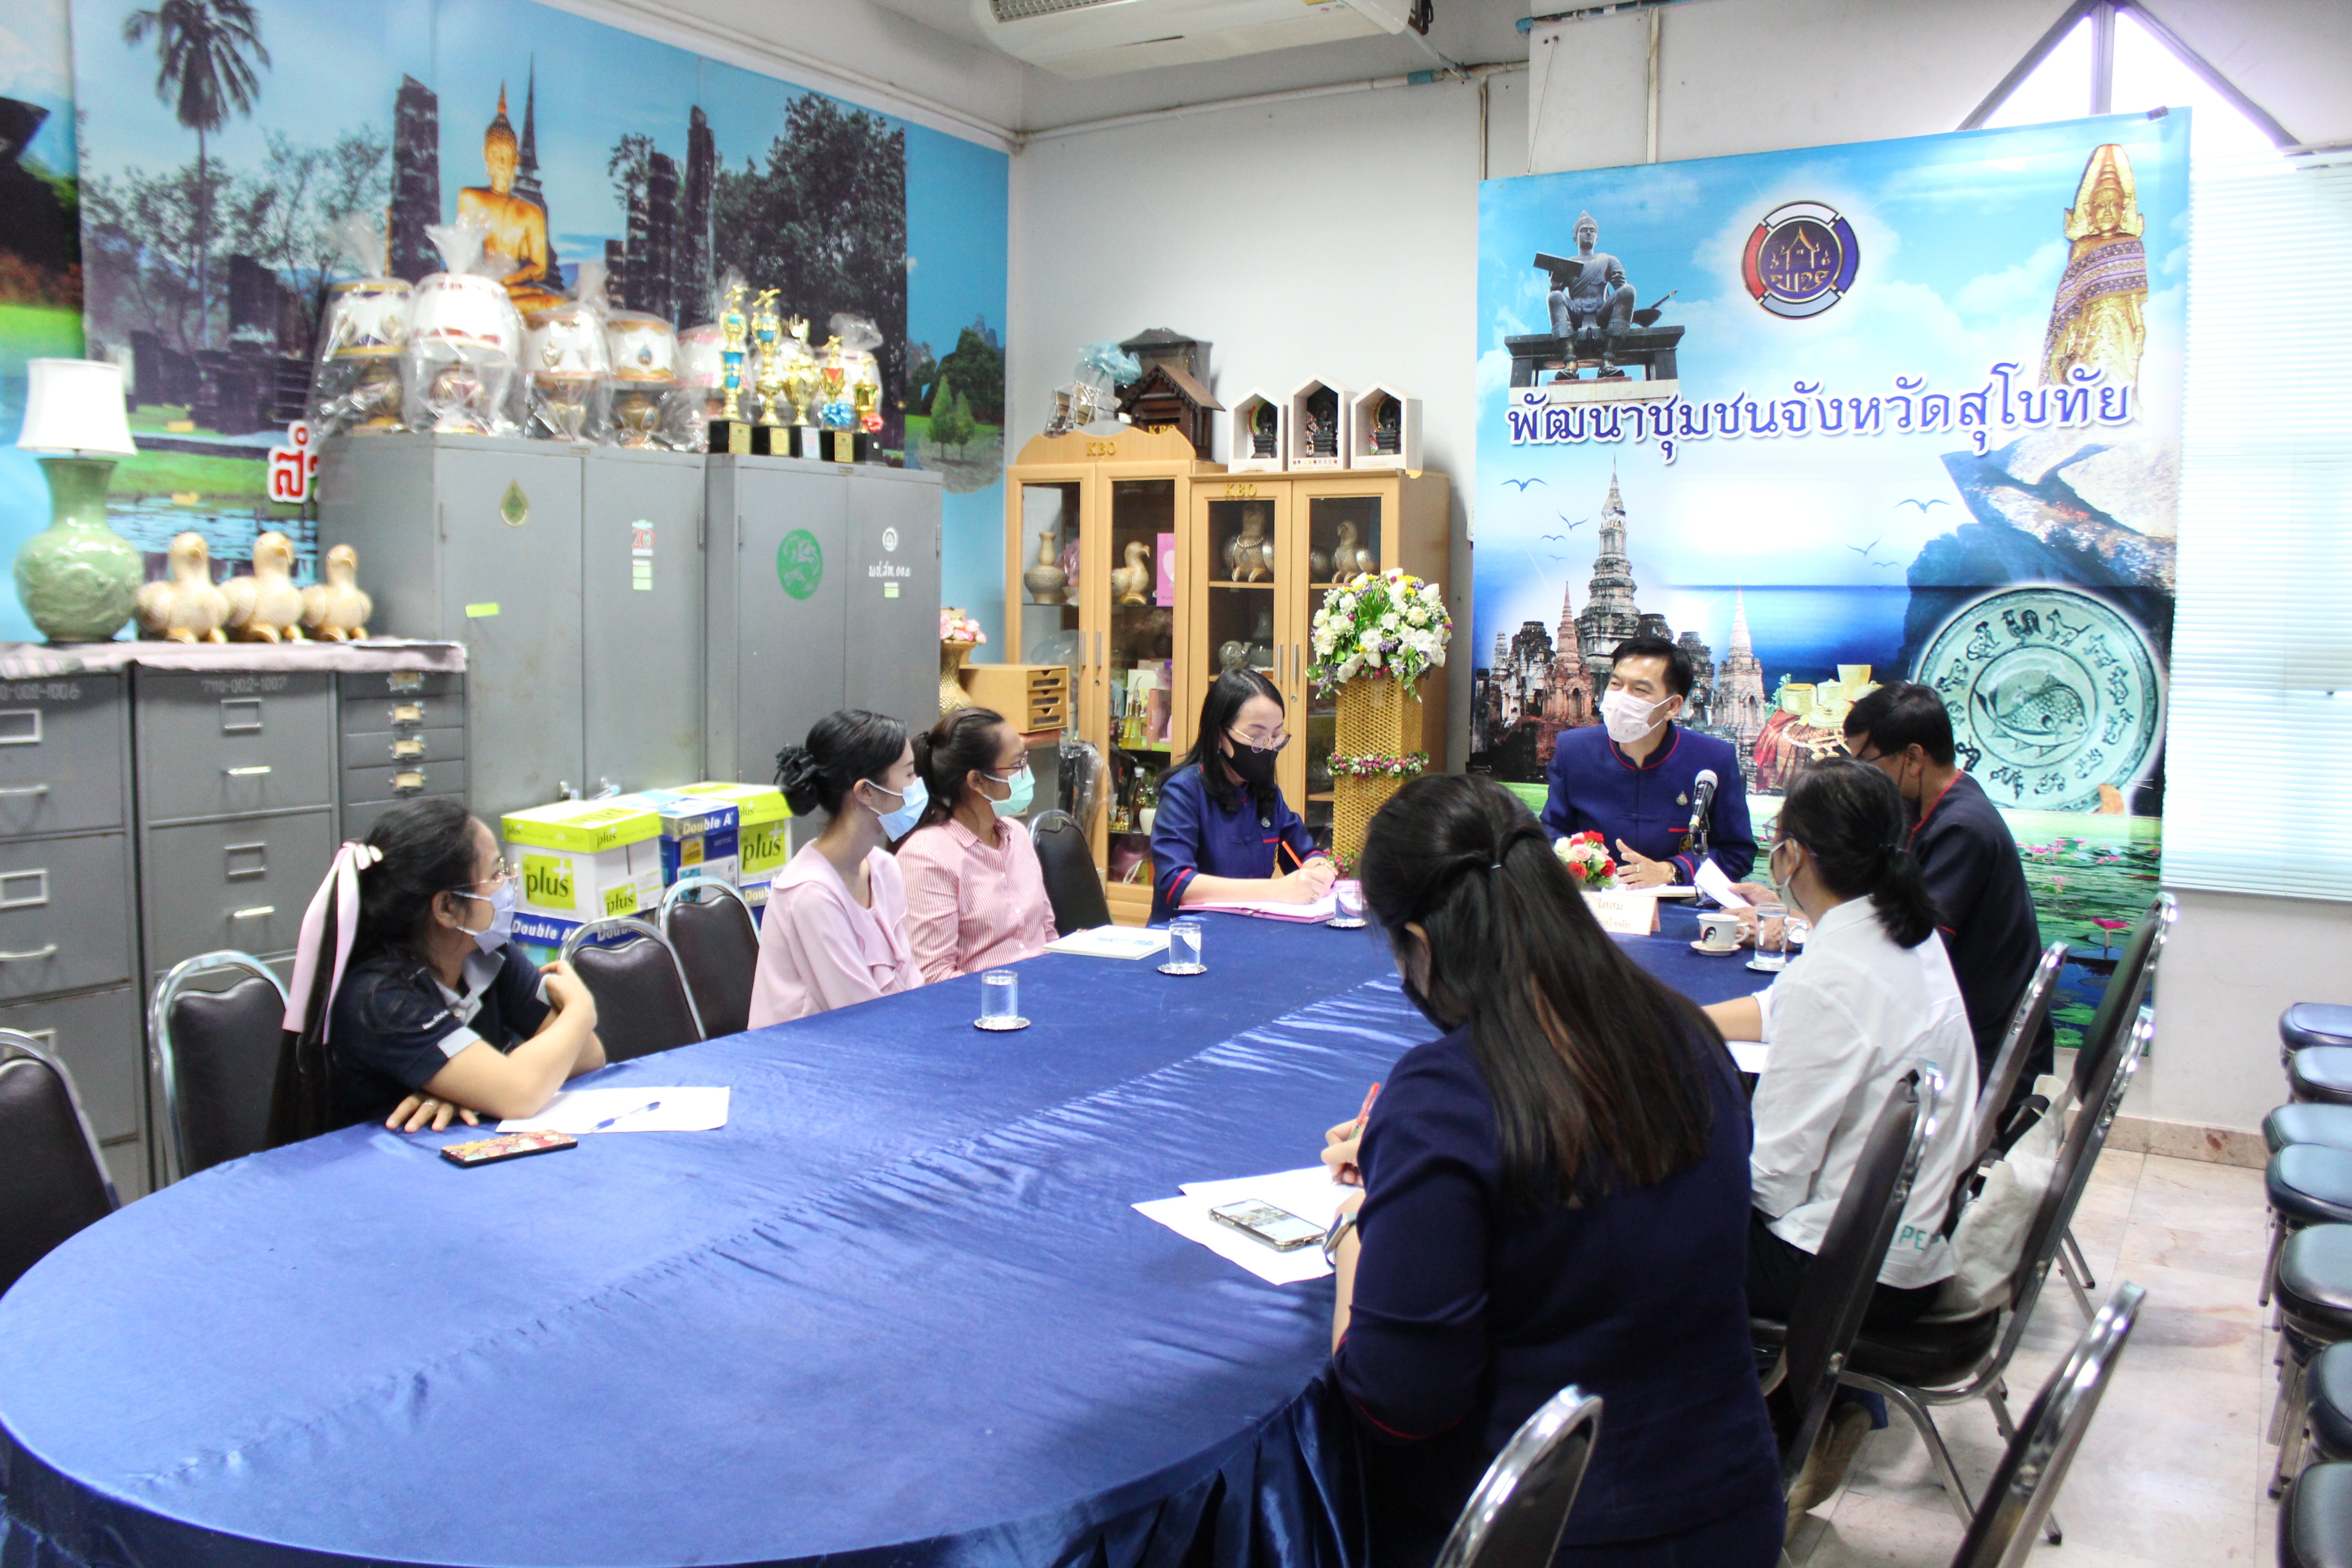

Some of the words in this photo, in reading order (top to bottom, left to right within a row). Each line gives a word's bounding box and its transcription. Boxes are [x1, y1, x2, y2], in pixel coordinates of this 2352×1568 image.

[1508, 362, 2128, 461] พัฒนาชุมชนจังหวัดสุโขทัย
[1086, 442, 1116, 456] KBO
[1224, 483, 1256, 497] KBO
[682, 817, 720, 836] Double
[723, 813, 732, 827] A
[597, 832, 616, 848] plus
[742, 833, 781, 870] plus
[526, 866, 568, 900] plus
[607, 893, 633, 916] plus
[512, 920, 558, 940] Double
